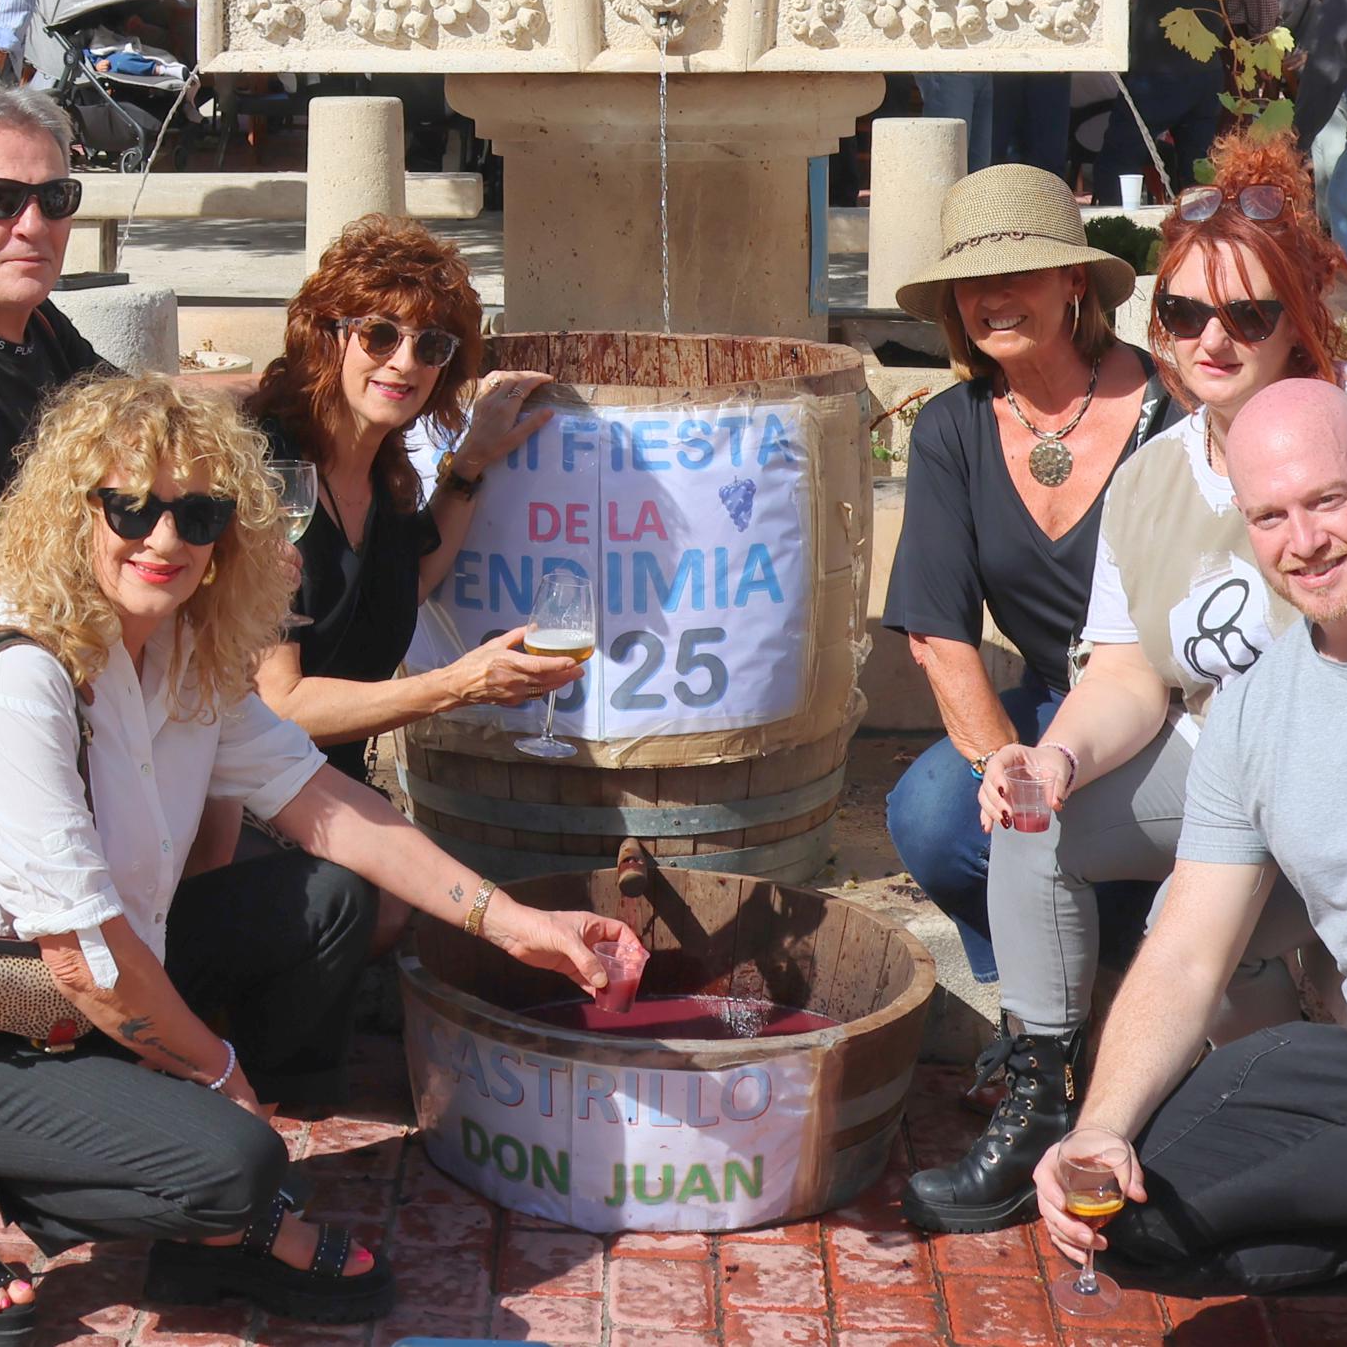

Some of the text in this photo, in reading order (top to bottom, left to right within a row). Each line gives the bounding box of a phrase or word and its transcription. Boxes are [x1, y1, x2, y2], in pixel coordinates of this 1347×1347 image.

[561, 412, 795, 472] FIESTA
[528, 500, 669, 544] DE LA
[434, 543, 784, 615] ENDIMIA
[480, 626, 729, 713] 25
[461, 1115, 765, 1208] DON JUAN
